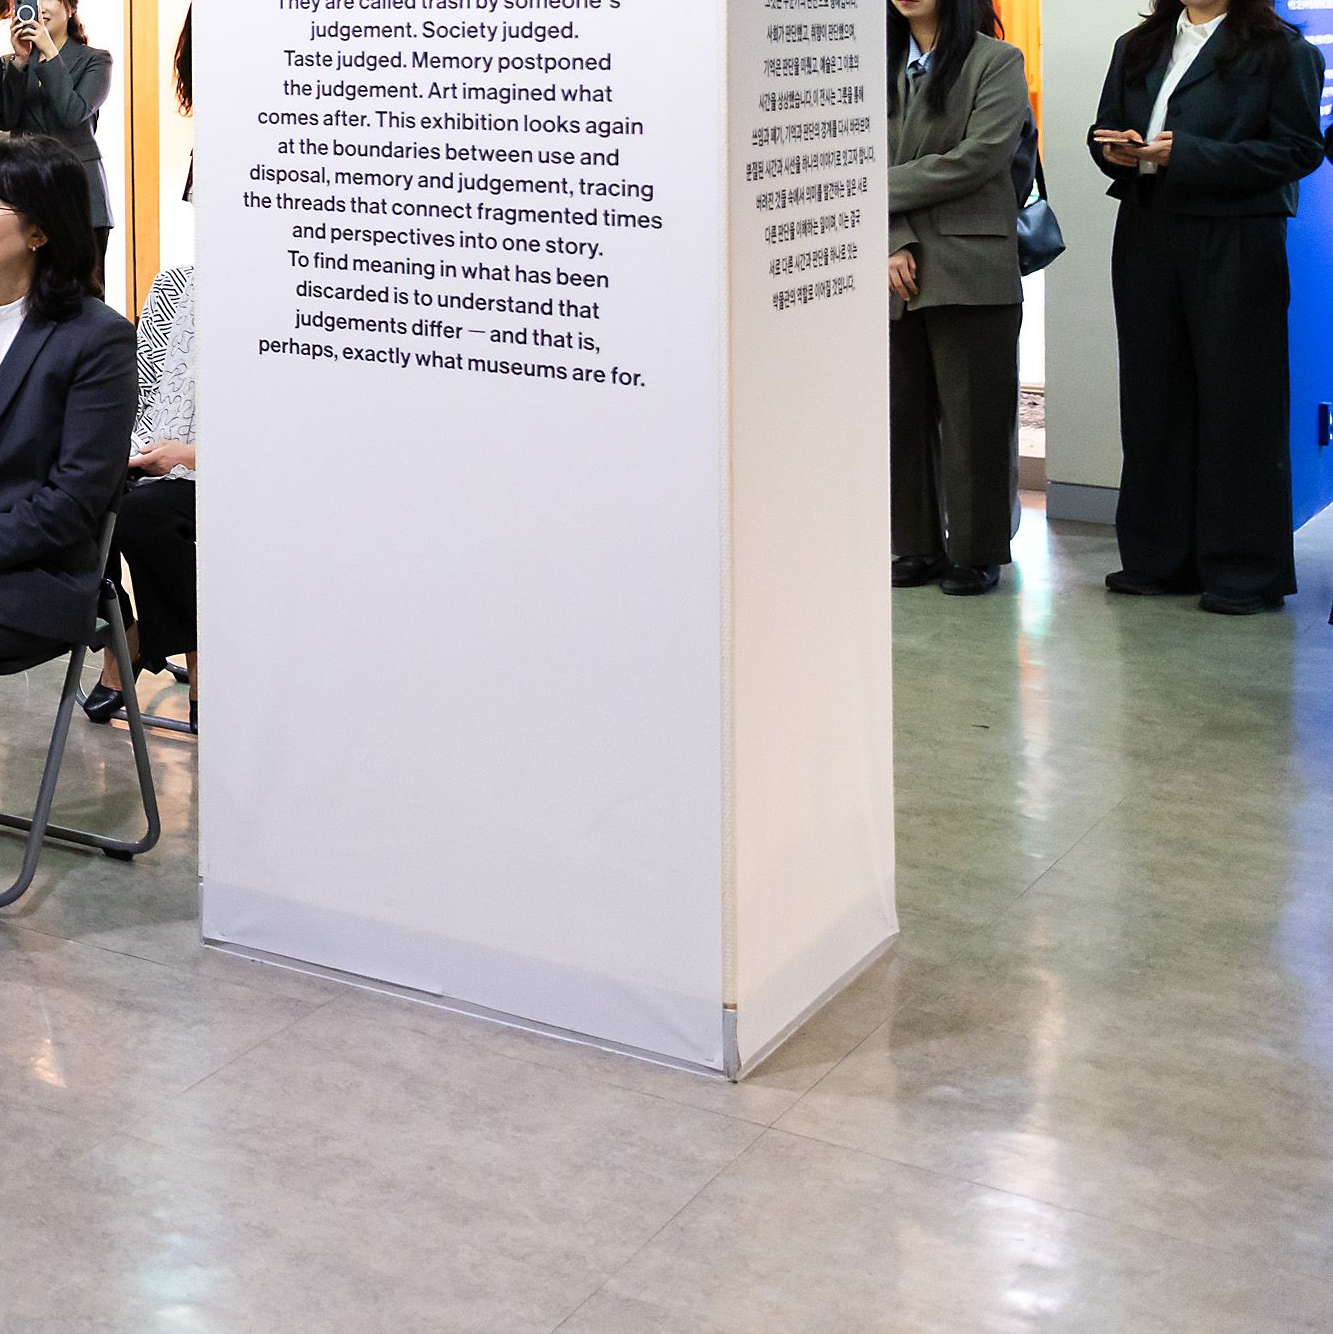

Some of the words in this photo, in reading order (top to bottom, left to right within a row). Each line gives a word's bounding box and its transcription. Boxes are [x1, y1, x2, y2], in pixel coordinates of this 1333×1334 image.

[309, 20, 418, 42] judgement.
[421, 20, 499, 43] Society
[500, 20, 579, 43] judged.
[283, 49, 333, 68] Taste
[335, 50, 408, 72] judged.
[411, 50, 494, 74] Memory
[497, 52, 612, 74] postponed
[282, 79, 313, 97] the
[314, 79, 424, 101] judgement.
[427, 81, 458, 100] Art
[462, 82, 556, 105] imagined
[560, 83, 613, 103] what
[257, 111, 319, 126] comes
[322, 109, 371, 128] after.
[374, 110, 416, 129] This
[420, 111, 519, 132] exhibition
[523, 114, 581, 134] looks
[585, 116, 644, 139] again
[277, 138, 296, 155] at
[298, 137, 329, 156] the
[332, 138, 441, 160] boundaries
[445, 142, 533, 163] between
[537, 150, 576, 165] use
[579, 147, 620, 167] and
[249, 163, 331, 187] disposal,
[334, 171, 414, 191] memory
[417, 171, 454, 190] and
[456, 172, 574, 198] judgement,
[578, 178, 654, 203] tracing
[242, 190, 272, 209] the
[275, 192, 347, 213] threads
[349, 196, 388, 215] that
[391, 202, 473, 220] connect
[476, 202, 598, 226] fragmented
[602, 208, 663, 230] times
[291, 222, 326, 240] and
[330, 227, 456, 248] perspectives
[459, 230, 498, 250] into
[501, 237, 541, 253] one
[545, 236, 604, 260] story.
[286, 249, 310, 268] To
[312, 251, 349, 271] find
[352, 257, 436, 281] meaning
[439, 259, 457, 278] in
[460, 261, 511, 282] what
[515, 264, 552, 285] has
[556, 266, 609, 289] been
[295, 279, 389, 304] discarded
[393, 286, 409, 305] is
[412, 289, 434, 307] to
[437, 292, 554, 316] understand
[557, 299, 600, 320] that
[294, 308, 408, 335] judgements
[411, 318, 464, 340] differ
[489, 327, 528, 346] and
[531, 328, 574, 349] that
[577, 331, 600, 355] is,
[258, 337, 339, 362] perhaps,
[341, 346, 412, 369] exactly
[414, 349, 464, 371] what
[467, 357, 568, 380] museums
[571, 367, 606, 384] are
[610, 366, 646, 387] for.
